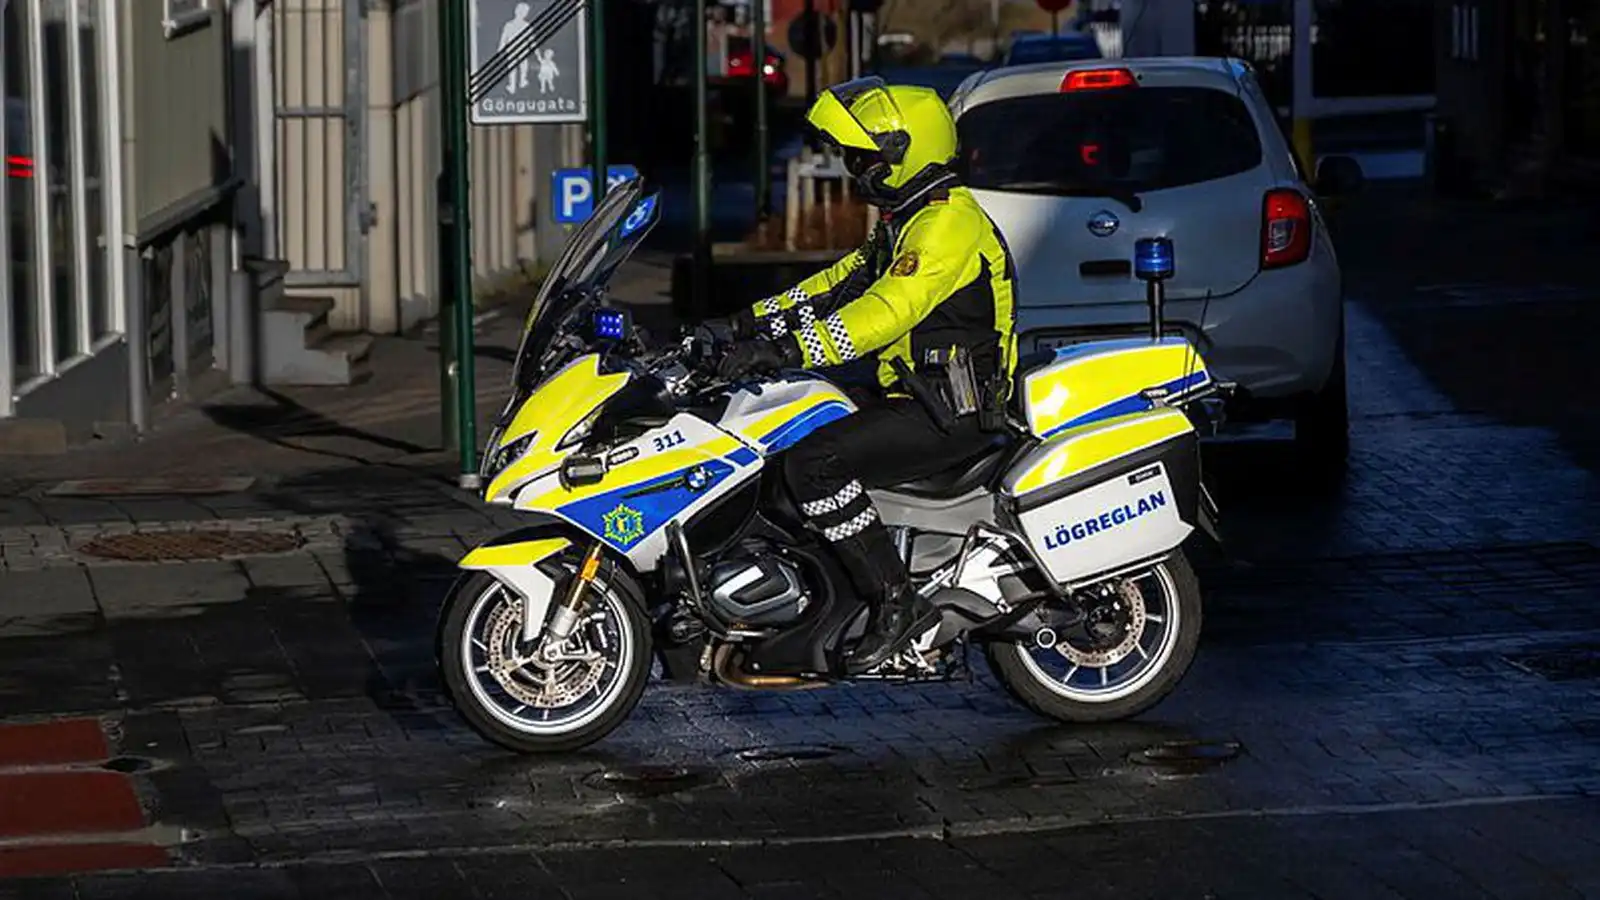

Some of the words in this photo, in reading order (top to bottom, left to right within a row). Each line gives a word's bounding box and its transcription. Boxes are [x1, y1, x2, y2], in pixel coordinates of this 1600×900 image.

[482, 97, 576, 112] Göngugata
[562, 176, 592, 217] P
[653, 430, 685, 451] 311
[1044, 490, 1167, 550] LÖGREGLAN
